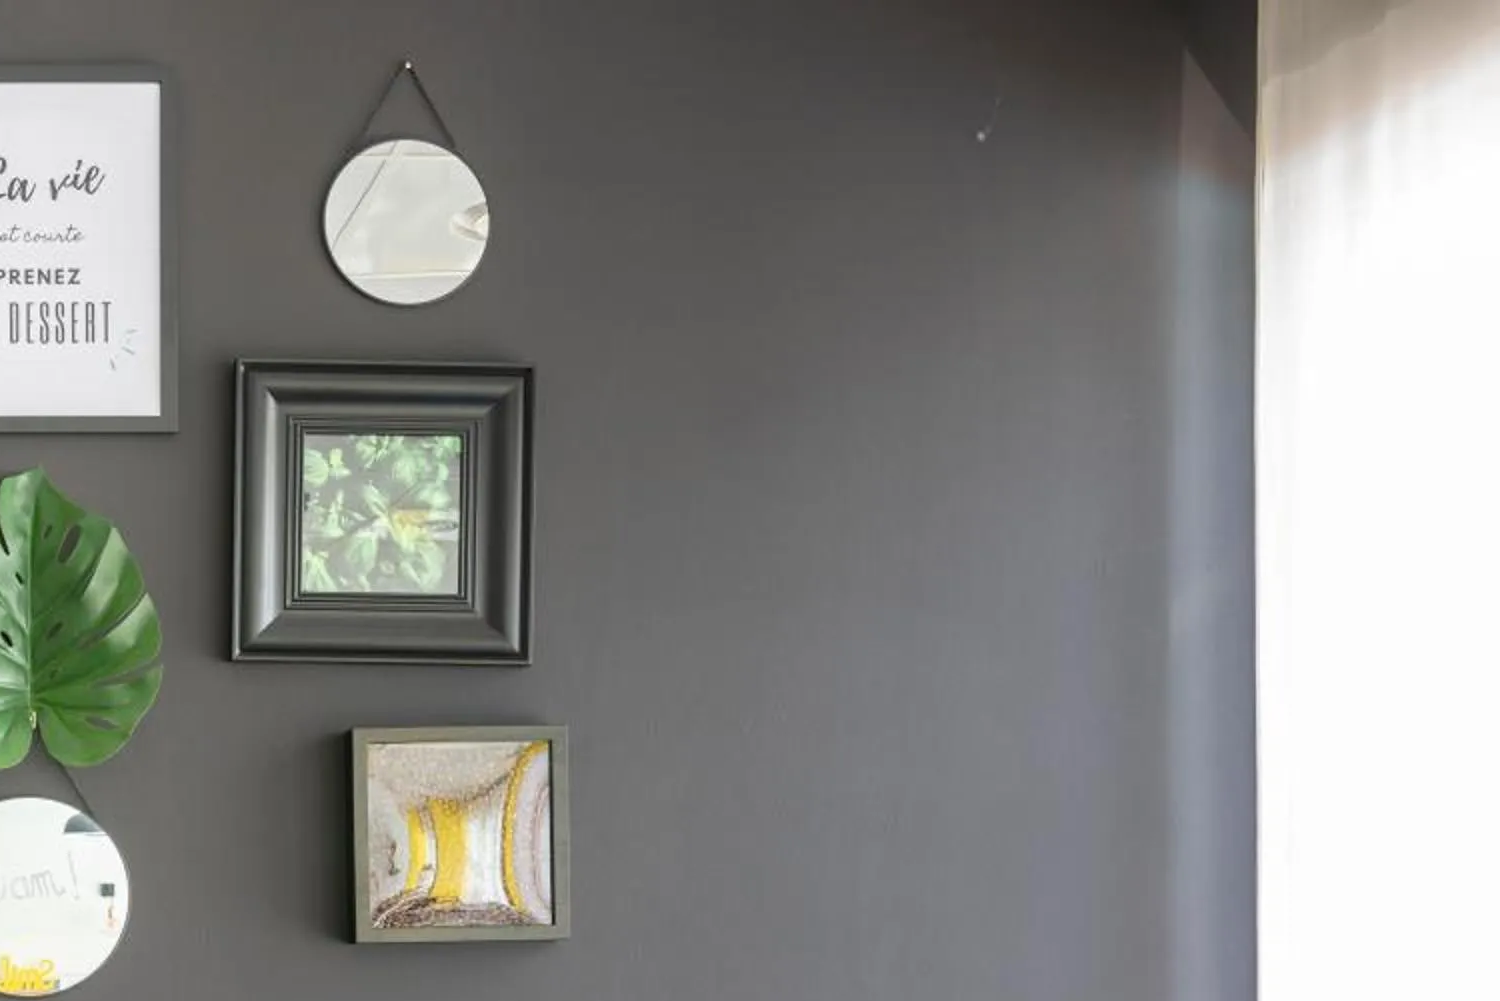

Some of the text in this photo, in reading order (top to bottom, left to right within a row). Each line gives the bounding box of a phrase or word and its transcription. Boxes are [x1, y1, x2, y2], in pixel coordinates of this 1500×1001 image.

[49, 159, 106, 201] vie
[23, 224, 85, 243] courte
[8, 302, 112, 344] DESSERT
